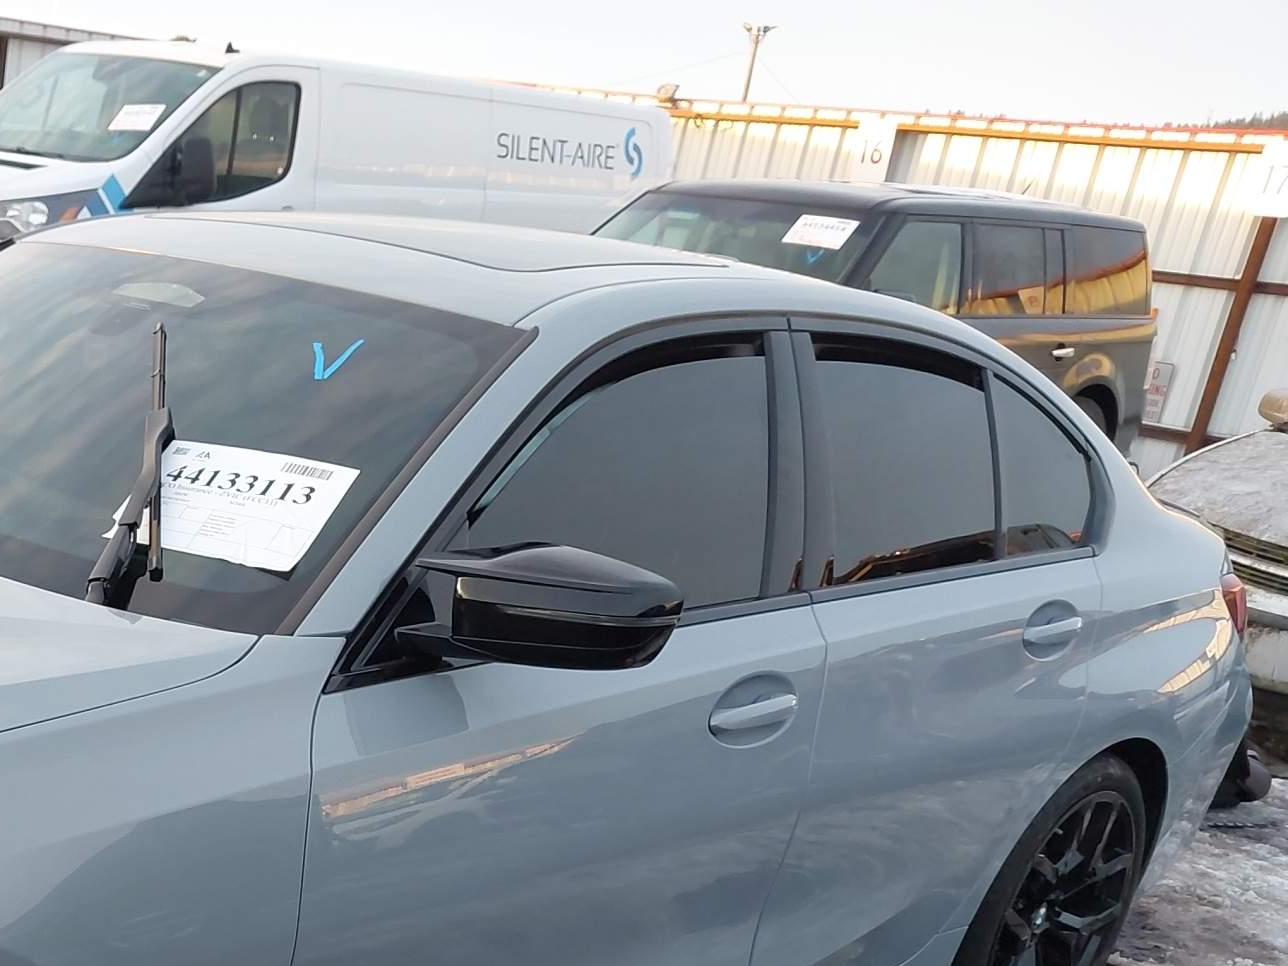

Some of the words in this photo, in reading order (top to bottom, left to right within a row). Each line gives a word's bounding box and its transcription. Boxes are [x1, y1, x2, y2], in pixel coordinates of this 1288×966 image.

[496, 132, 616, 170] SILENT-AIRE
[860, 139, 883, 164] 16
[166, 465, 316, 504] 44133113
